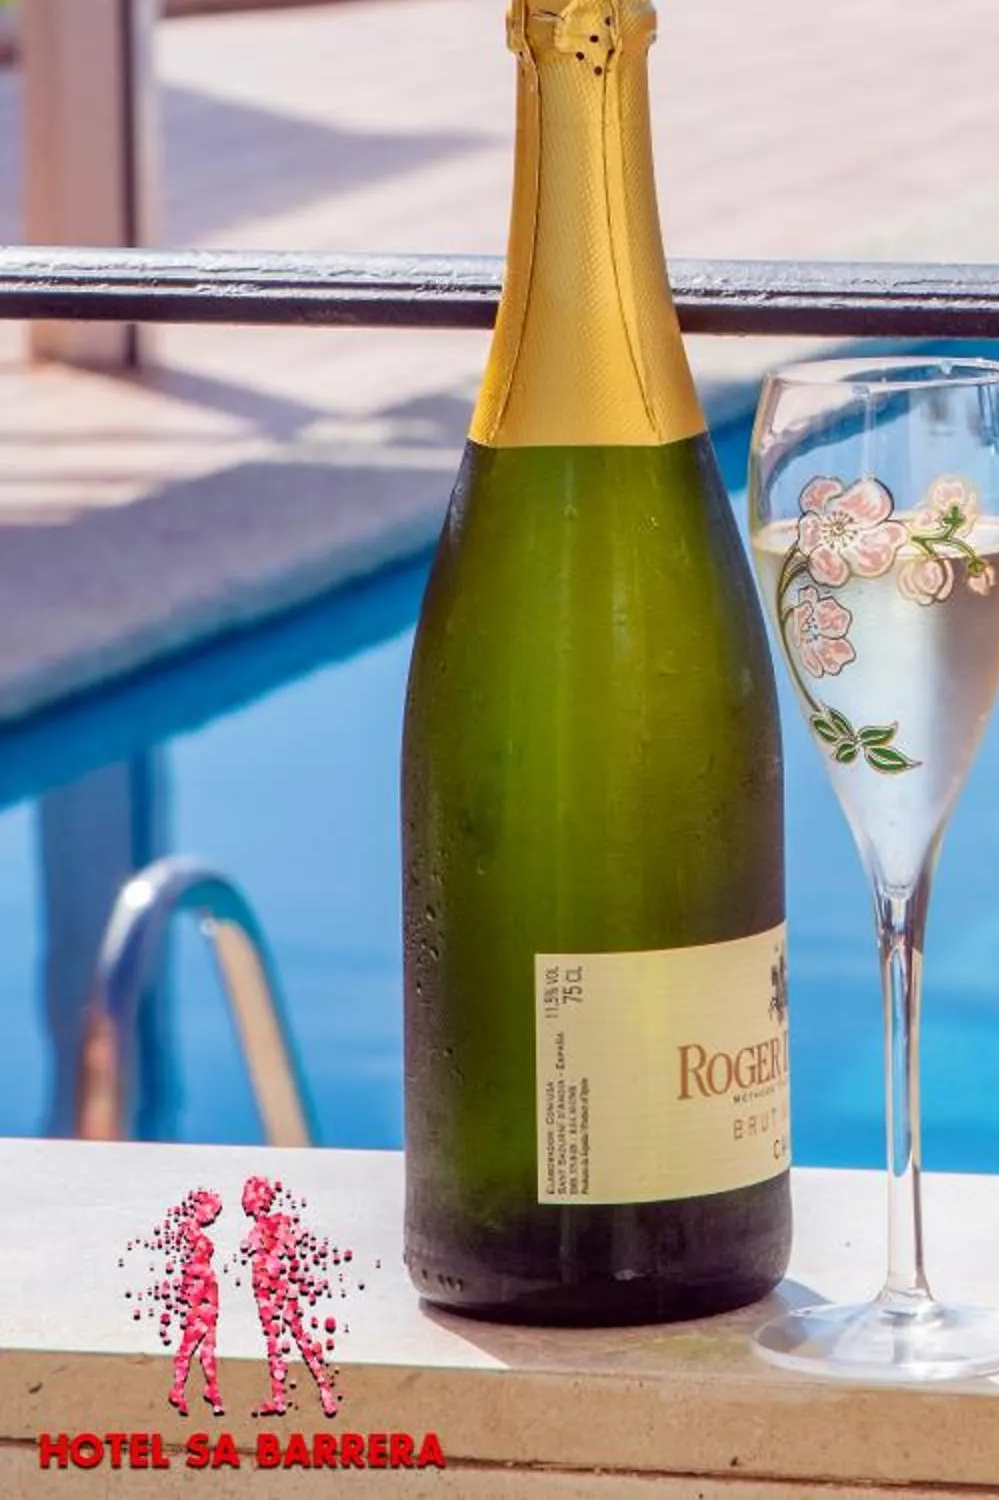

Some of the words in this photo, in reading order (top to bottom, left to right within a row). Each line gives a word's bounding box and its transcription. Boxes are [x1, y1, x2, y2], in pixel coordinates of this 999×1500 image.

[565, 965, 583, 983] CL
[563, 986, 583, 1004] 75
[677, 1037, 781, 1102] ROGER
[733, 1107, 777, 1141] BRUT
